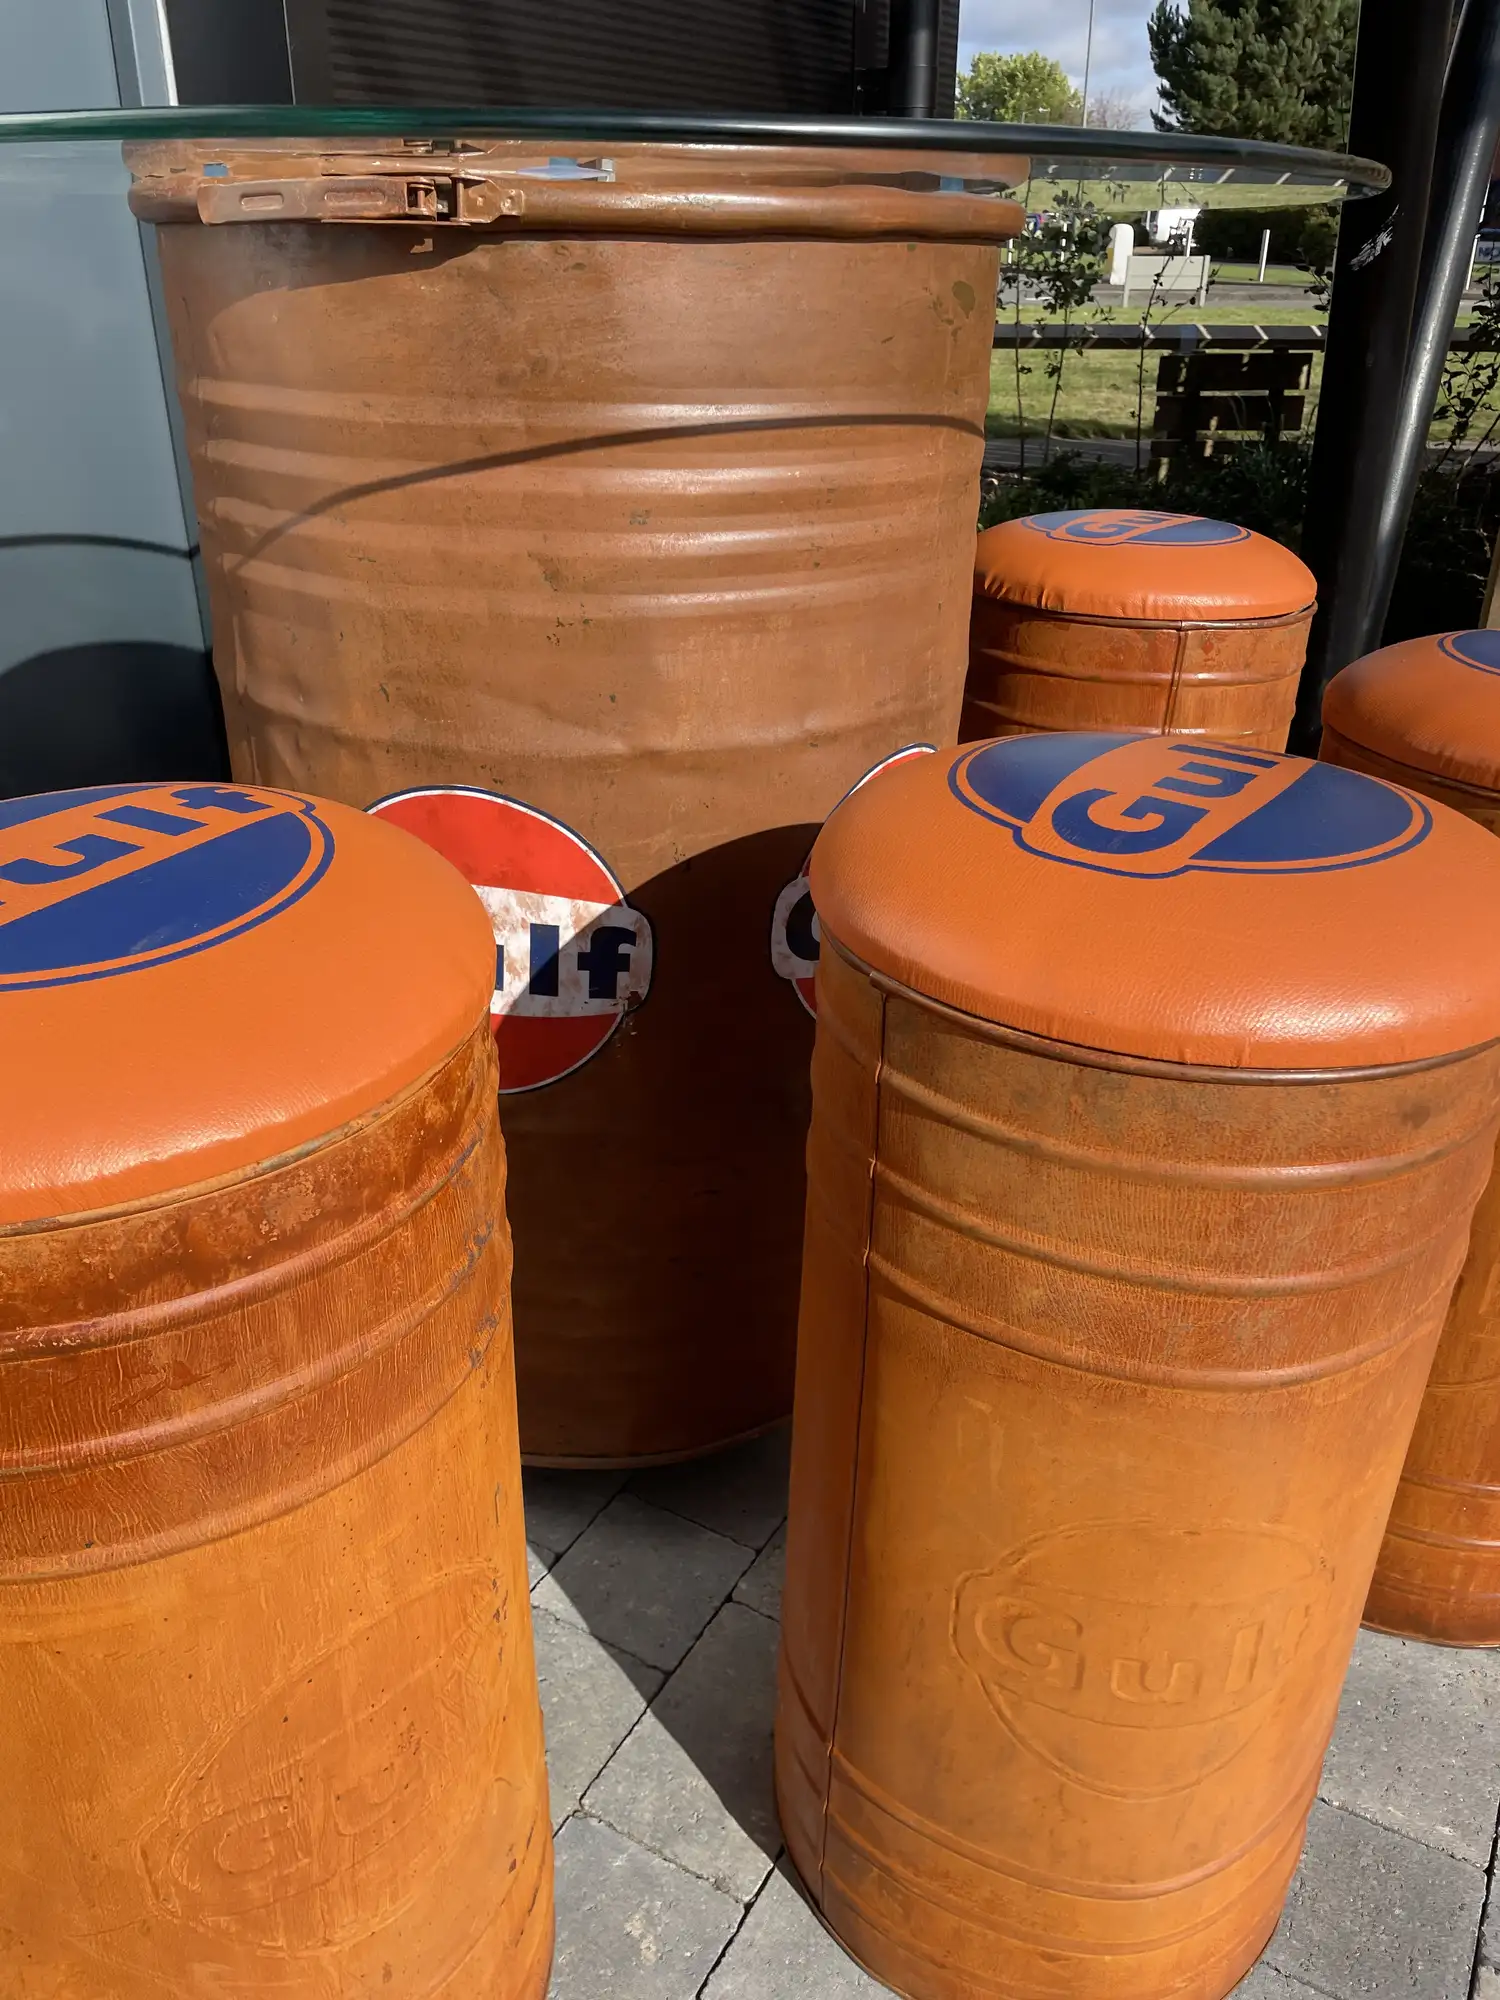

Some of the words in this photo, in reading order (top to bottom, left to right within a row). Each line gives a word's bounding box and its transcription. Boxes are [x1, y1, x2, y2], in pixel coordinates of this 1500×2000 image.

[1065, 511, 1188, 539] Gul
[0, 786, 276, 906] ulf
[495, 923, 637, 999] lf
